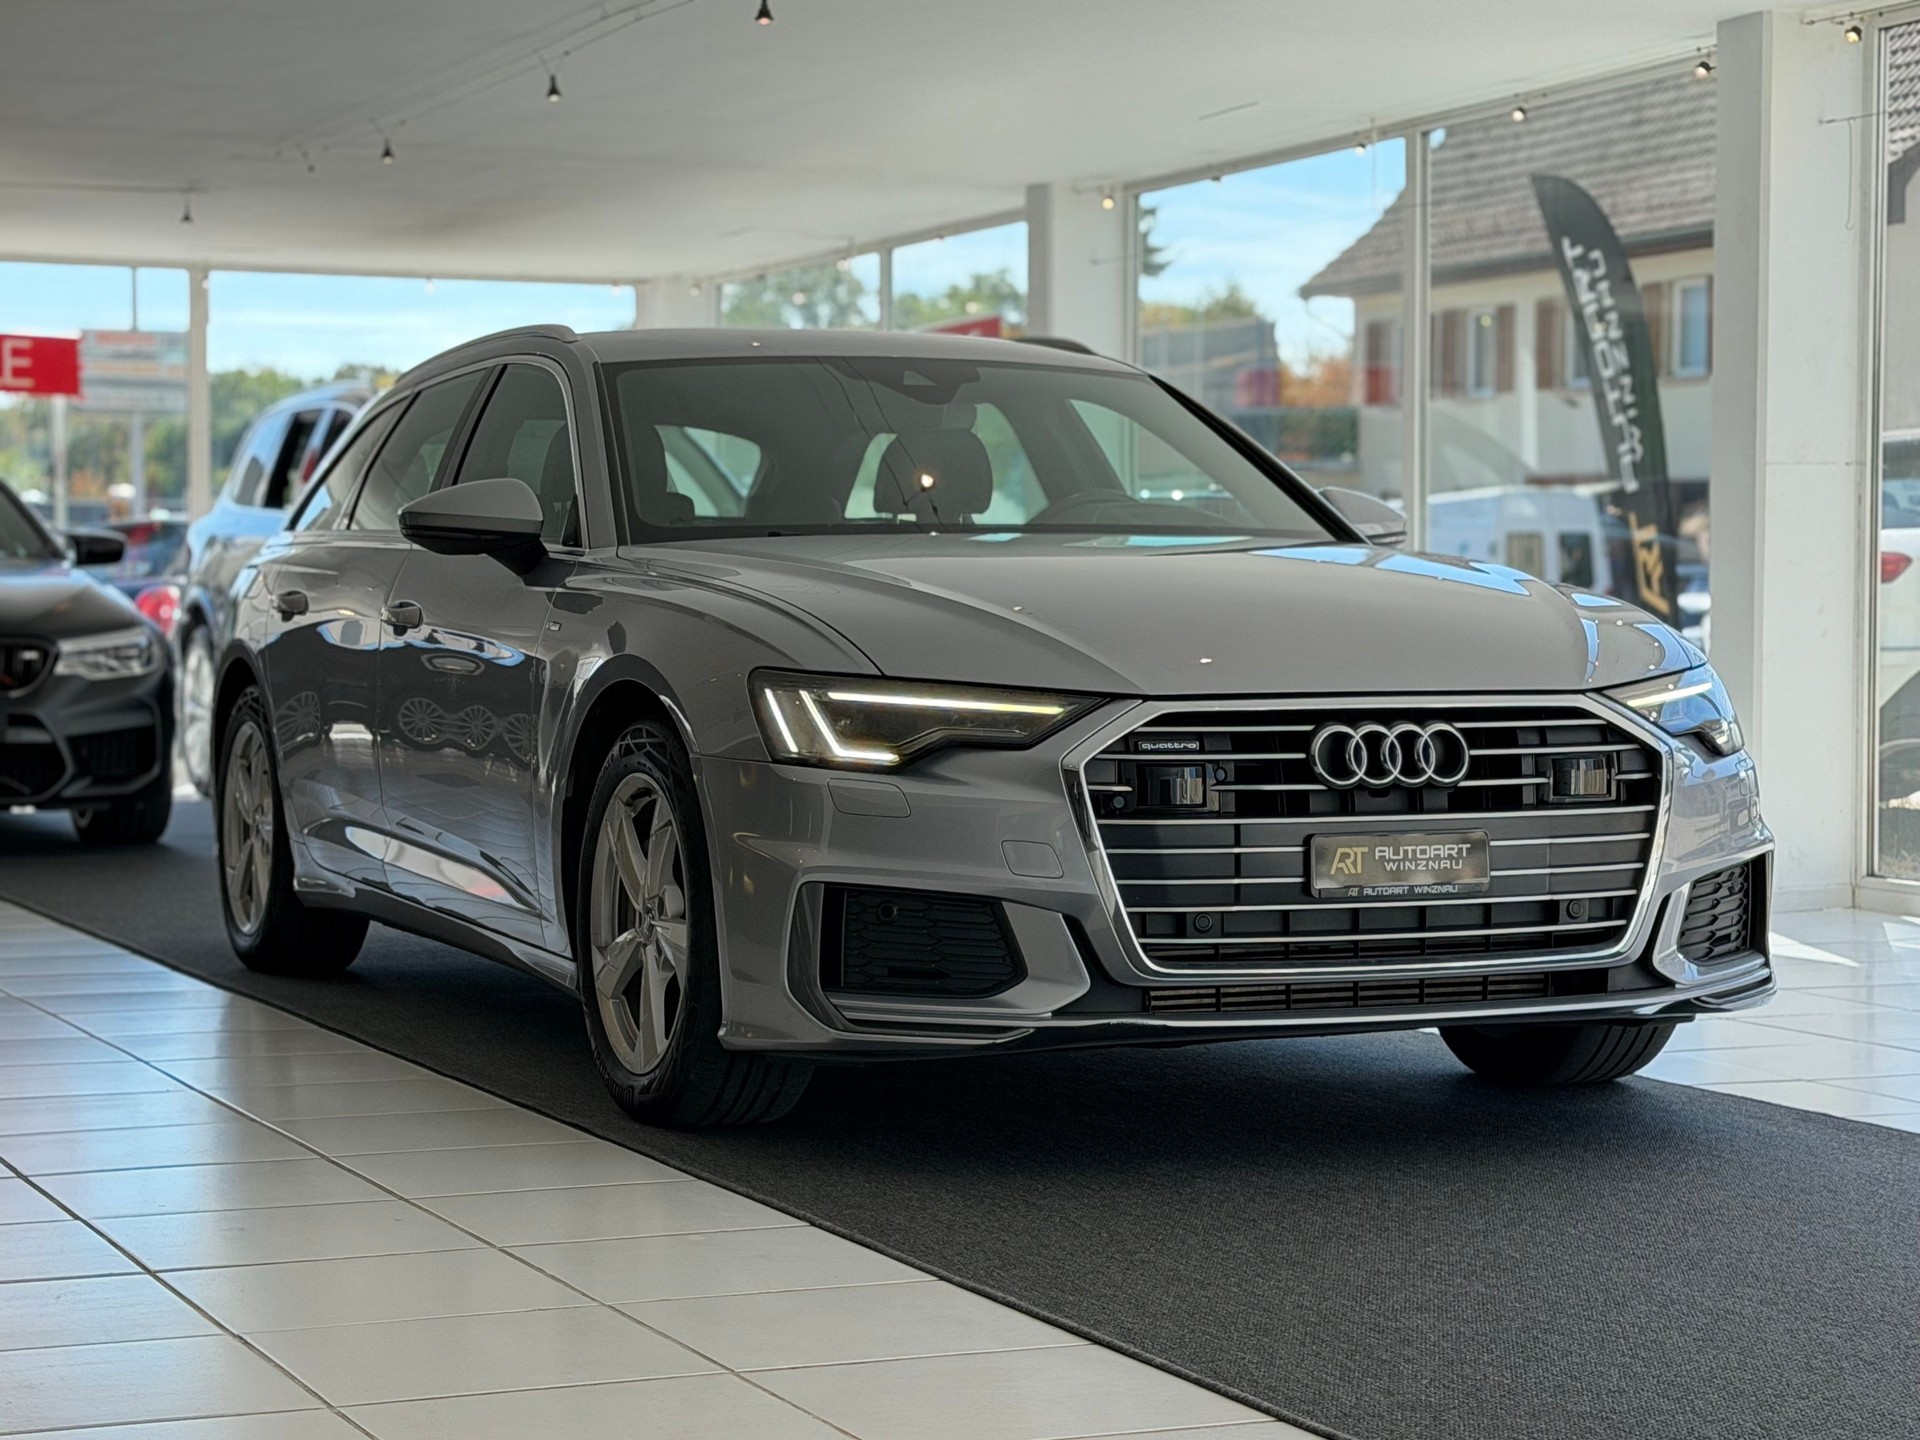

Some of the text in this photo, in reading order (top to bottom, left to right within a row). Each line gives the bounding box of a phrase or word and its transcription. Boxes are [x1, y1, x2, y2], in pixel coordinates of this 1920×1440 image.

[1141, 742, 1197, 750] quattro
[1375, 844, 1471, 860] AUTOART
[1384, 859, 1463, 872] WINZNAU
[1363, 885, 1409, 896] AUTOART
[1413, 884, 1458, 894] WINZNAU
